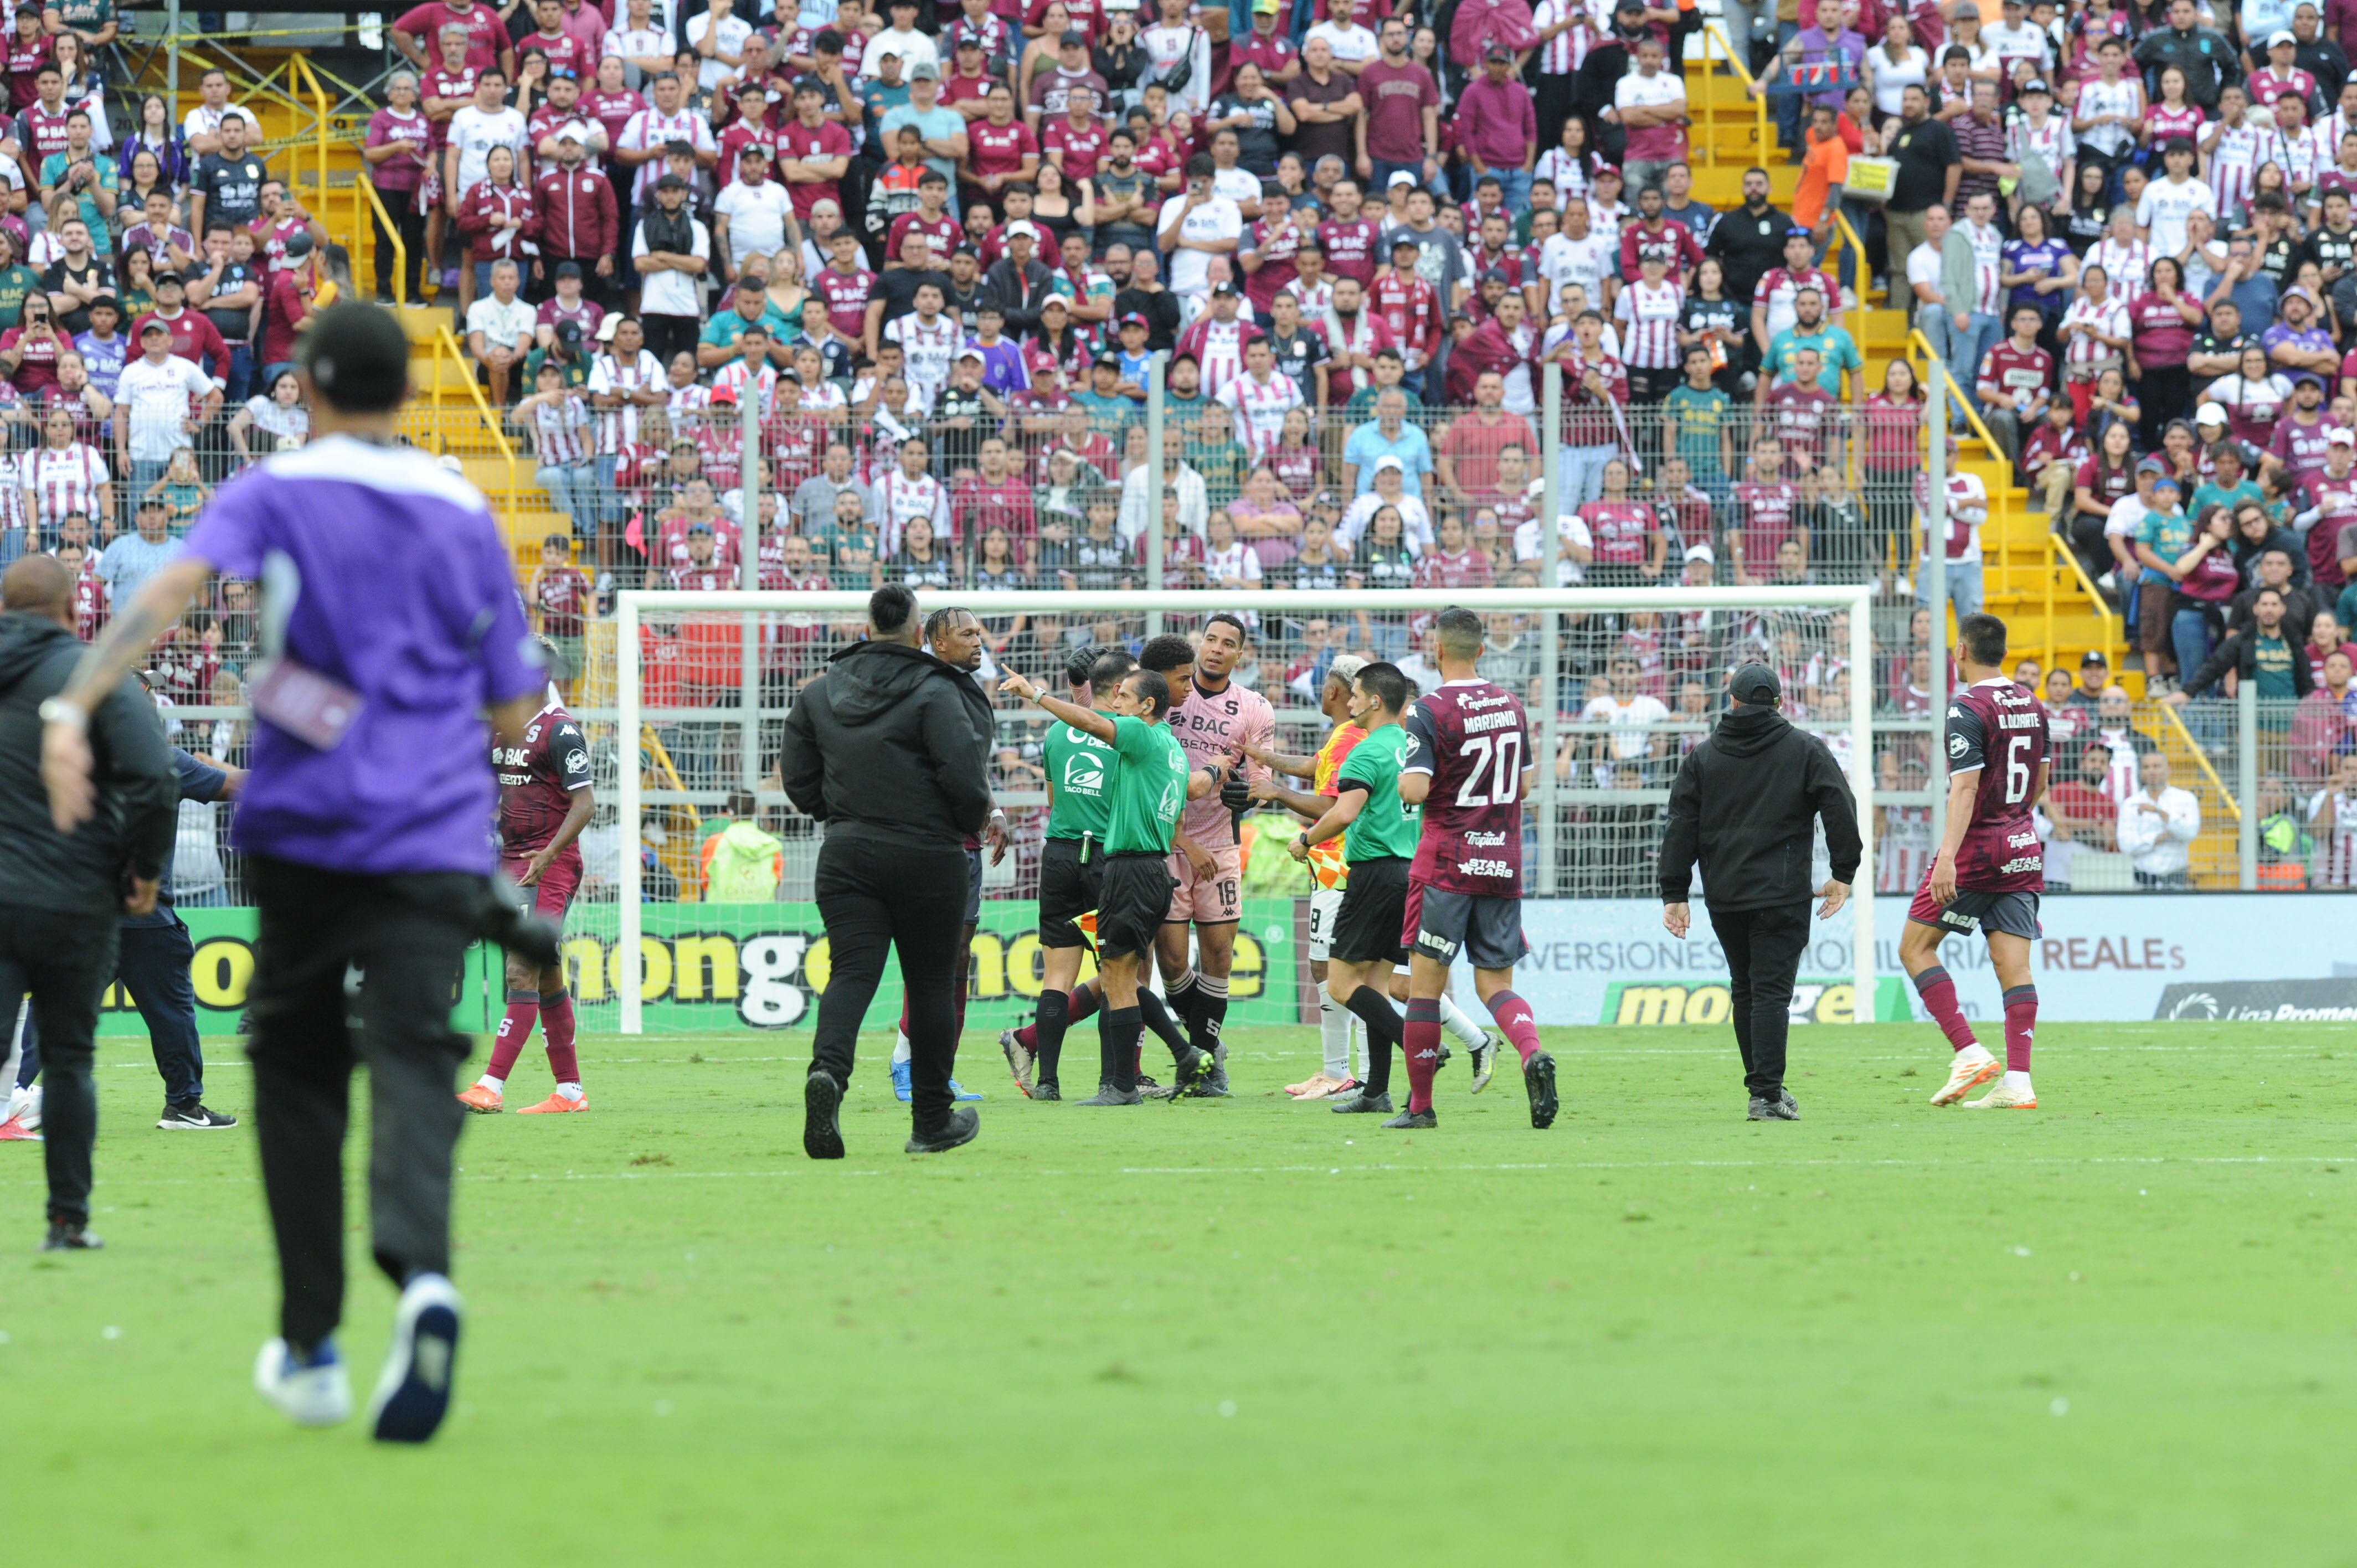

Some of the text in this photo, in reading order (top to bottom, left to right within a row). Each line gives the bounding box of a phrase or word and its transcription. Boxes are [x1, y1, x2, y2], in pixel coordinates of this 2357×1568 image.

[49, 126, 68, 138] BA
[1224, 700, 1239, 715] S
[1191, 715, 1231, 736] BAC
[1463, 711, 1517, 734] MARIANO
[526, 725, 542, 743] S
[505, 749, 530, 767] BAC
[1455, 732, 1521, 807] 20
[2006, 736, 2031, 804] 6
[1083, 788, 1102, 797] BELL
[1464, 831, 1506, 848] Tropical
[1469, 859, 1507, 869] STAR
[2010, 856, 2039, 866] STAR
[2013, 863, 2042, 873] CARS
[1473, 868, 1514, 878] CARS
[1216, 880, 1238, 906] 18
[1311, 908, 1321, 933] 8
[1942, 910, 1980, 930] RCA
[1418, 930, 1457, 956] RCA
